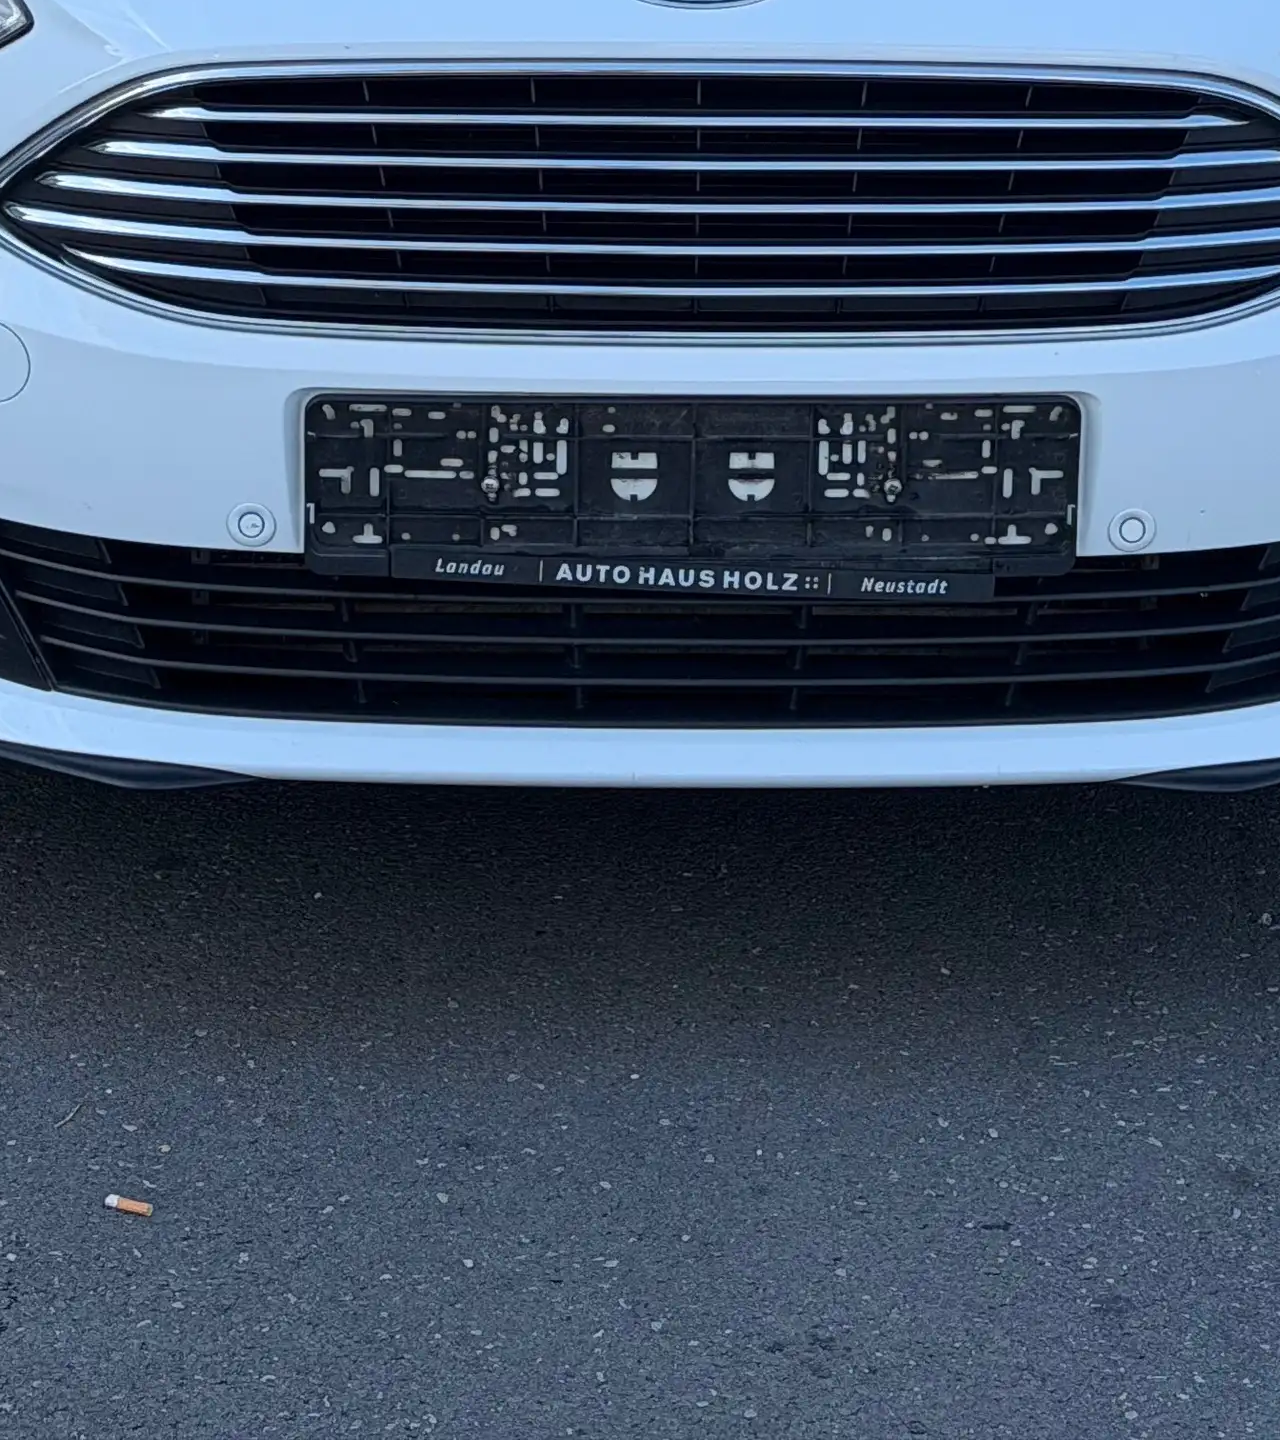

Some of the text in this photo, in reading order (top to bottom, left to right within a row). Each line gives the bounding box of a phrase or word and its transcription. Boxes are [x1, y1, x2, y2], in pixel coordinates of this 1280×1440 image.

[435, 557, 505, 576] Landau
[723, 570, 799, 591] HOLZ
[861, 576, 949, 595] Neustadt
